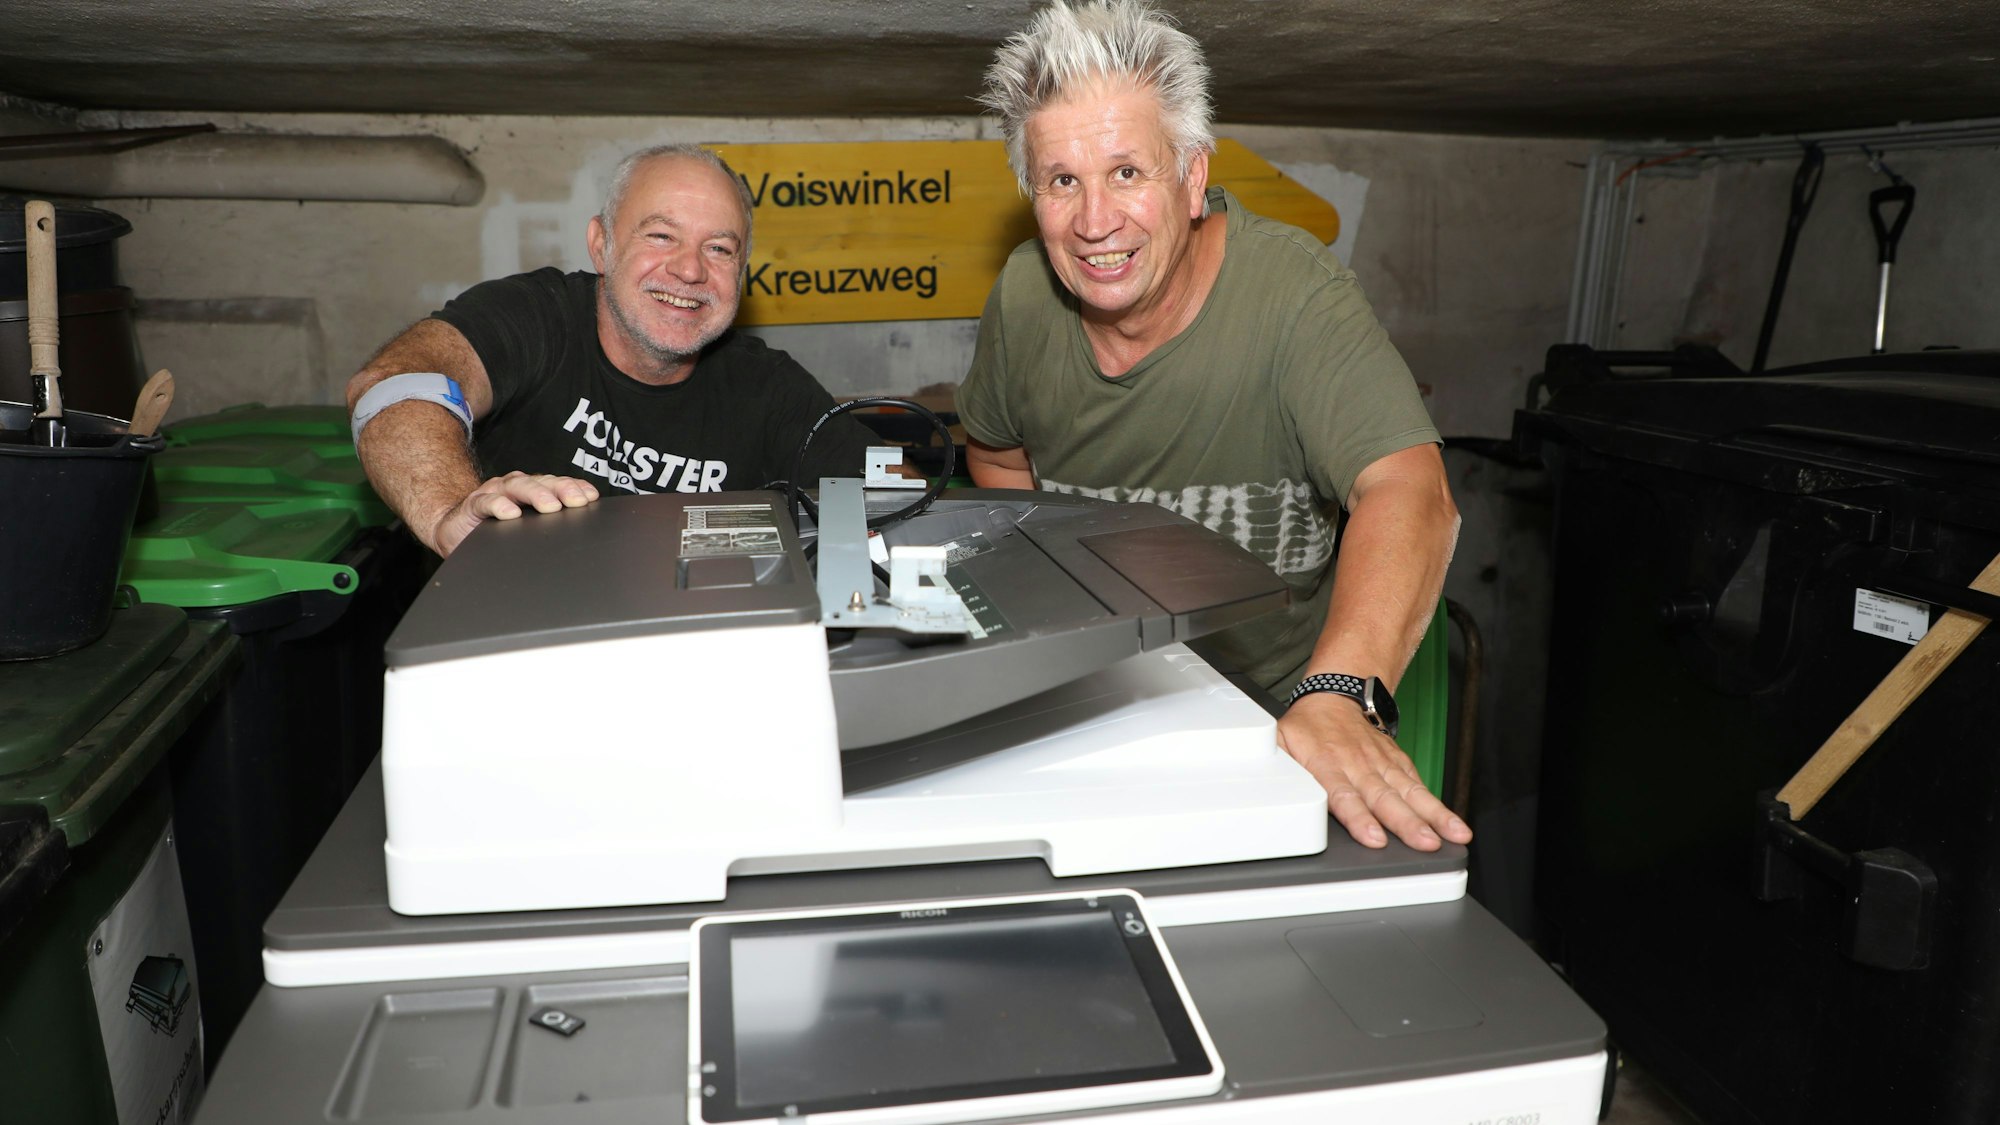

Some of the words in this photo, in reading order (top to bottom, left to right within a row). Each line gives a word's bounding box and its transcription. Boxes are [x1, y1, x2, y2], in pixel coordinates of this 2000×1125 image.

[740, 169, 951, 207] Voiswinkel
[746, 262, 937, 299] Kreuzweg
[900, 908, 947, 919] RICOH
